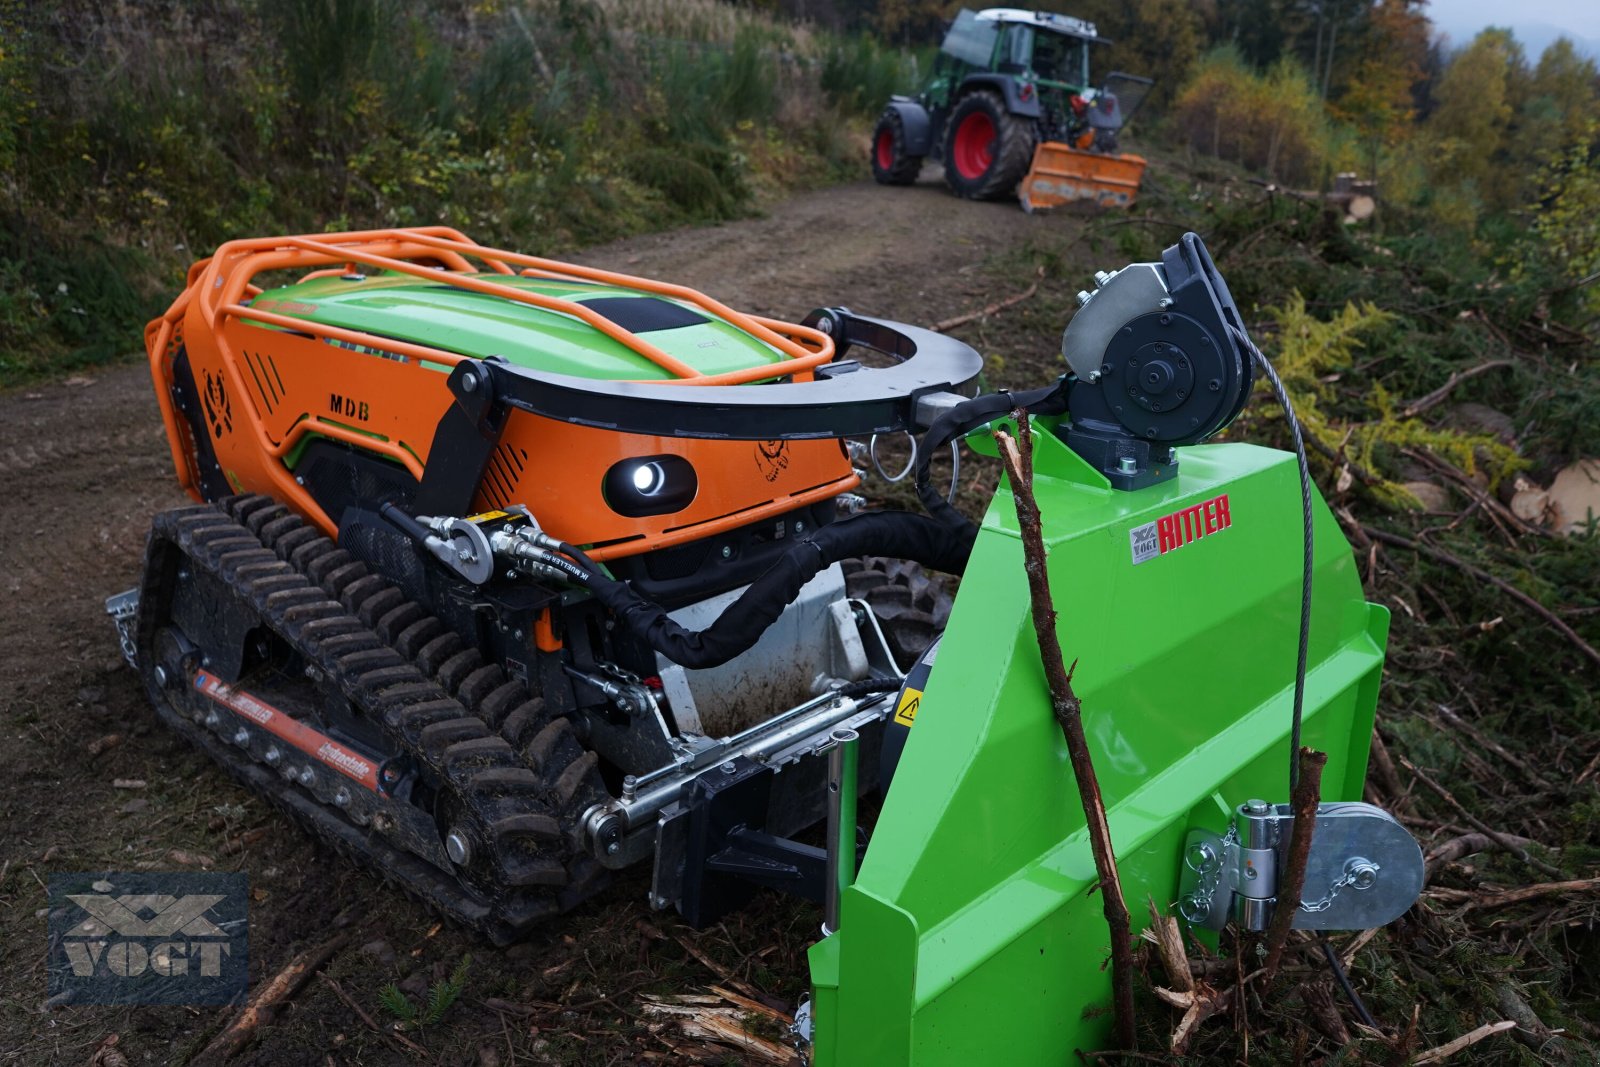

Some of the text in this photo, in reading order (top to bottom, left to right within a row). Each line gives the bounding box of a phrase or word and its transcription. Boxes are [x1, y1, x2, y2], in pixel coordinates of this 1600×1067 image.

[330, 393, 369, 422] MDB
[1157, 494, 1232, 555] RITTER
[1133, 538, 1157, 556] VOGT
[551, 556, 581, 576] MUELLER
